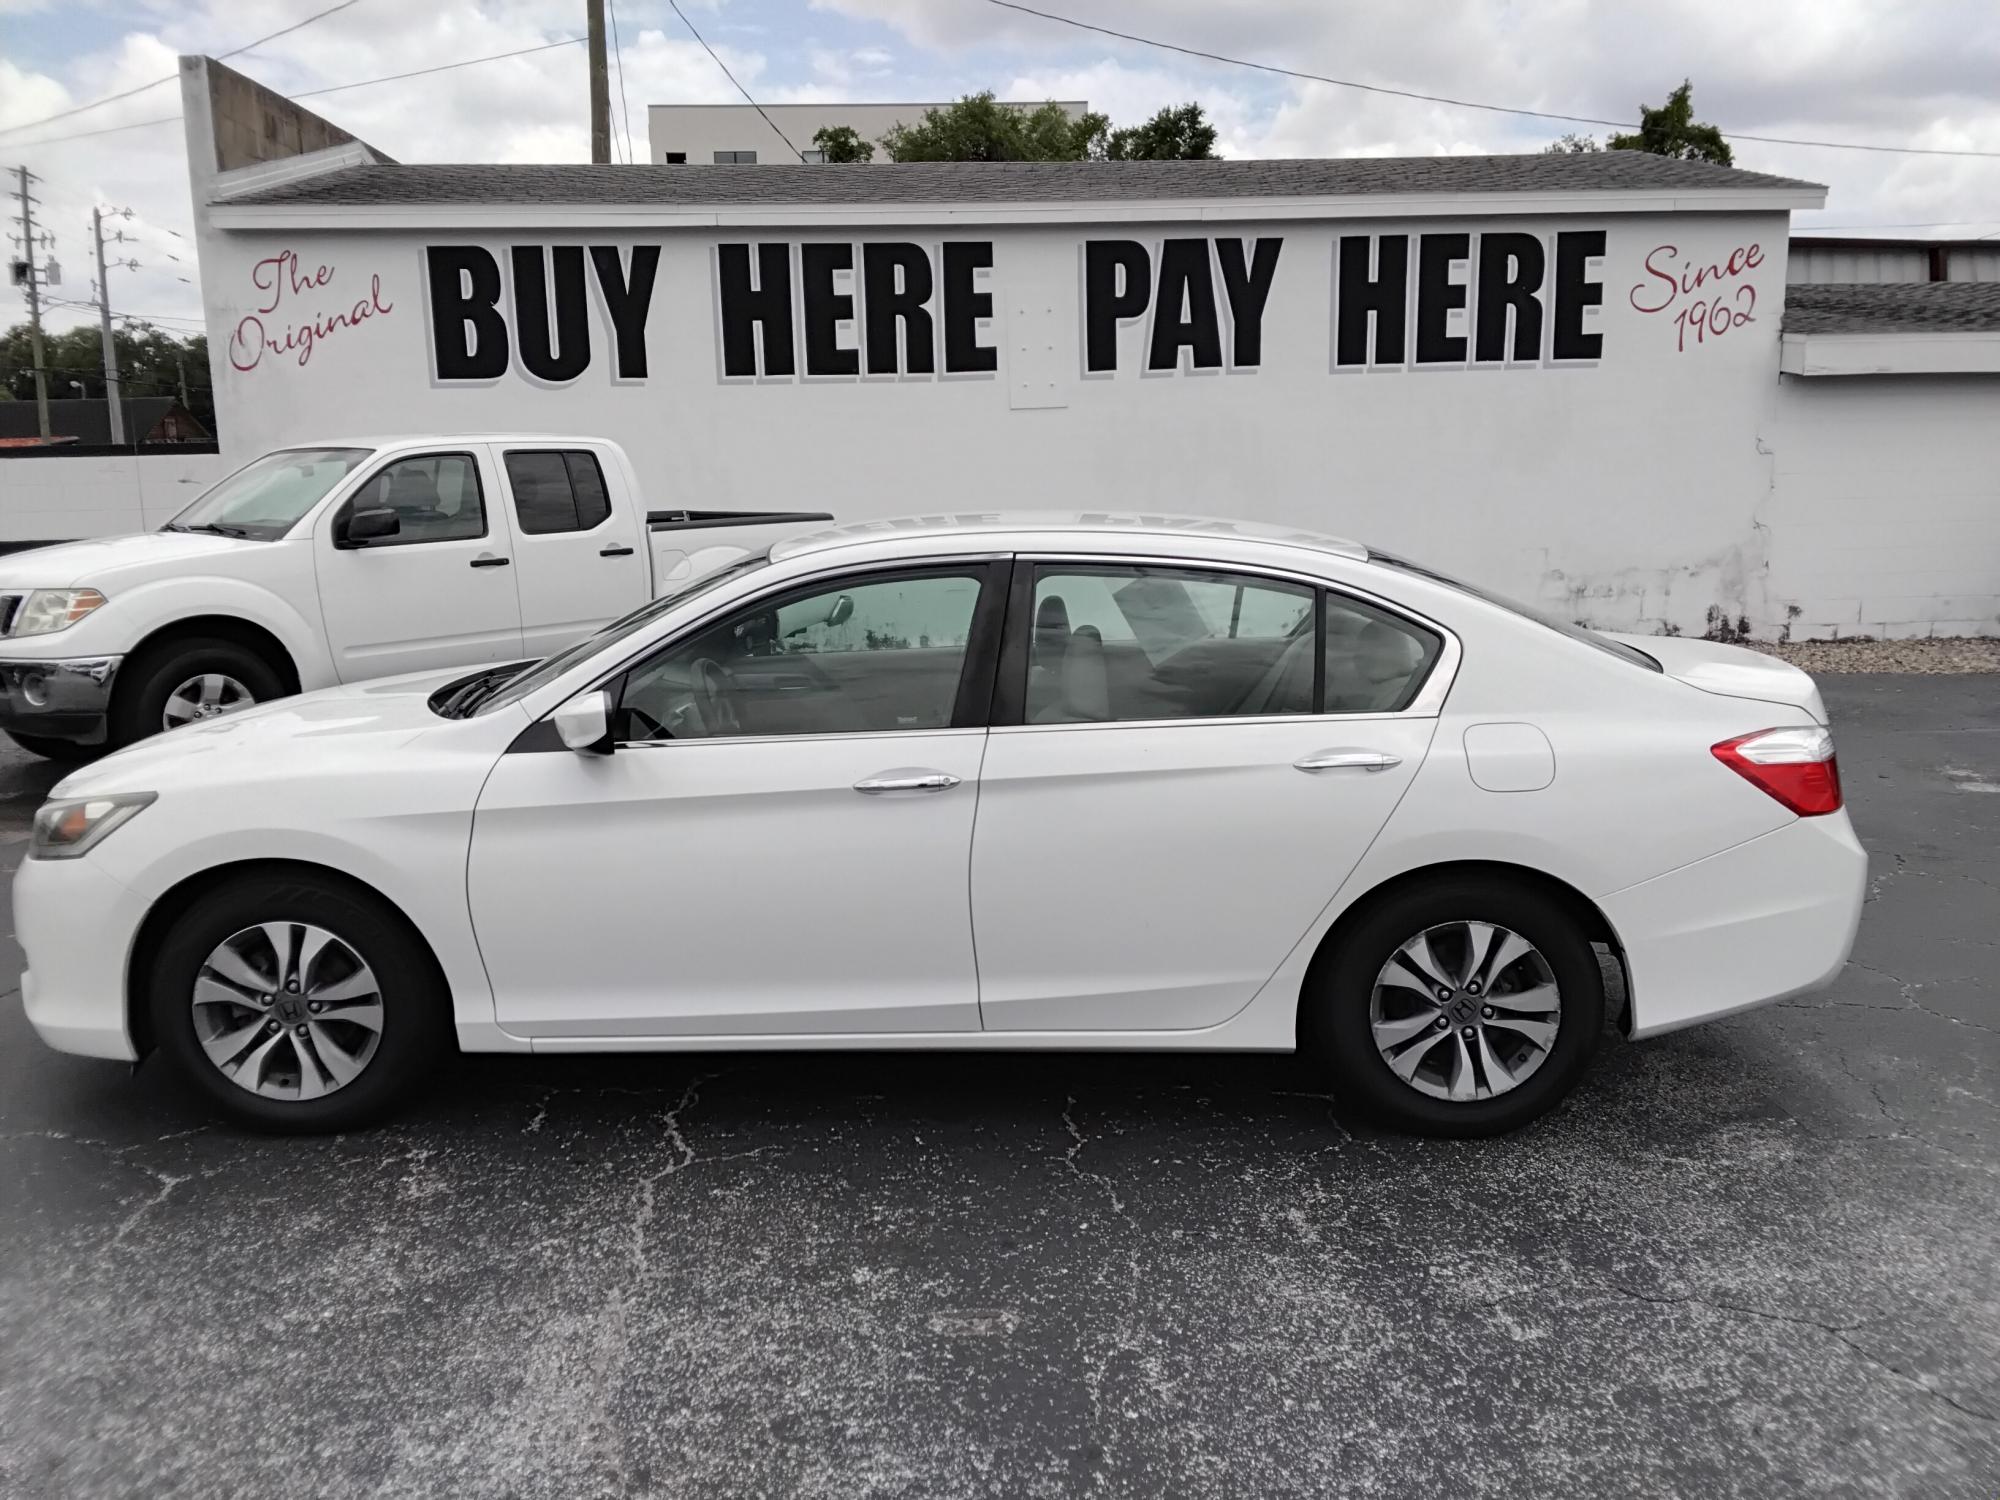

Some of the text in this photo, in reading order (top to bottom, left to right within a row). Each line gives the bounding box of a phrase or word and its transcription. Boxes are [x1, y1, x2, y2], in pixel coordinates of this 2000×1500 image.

[252, 249, 335, 314] The
[424, 229, 1608, 383] BUY HERE PAY HERE
[1629, 243, 1765, 313] Since
[229, 273, 393, 372] Original
[1673, 284, 1757, 353] 1962
